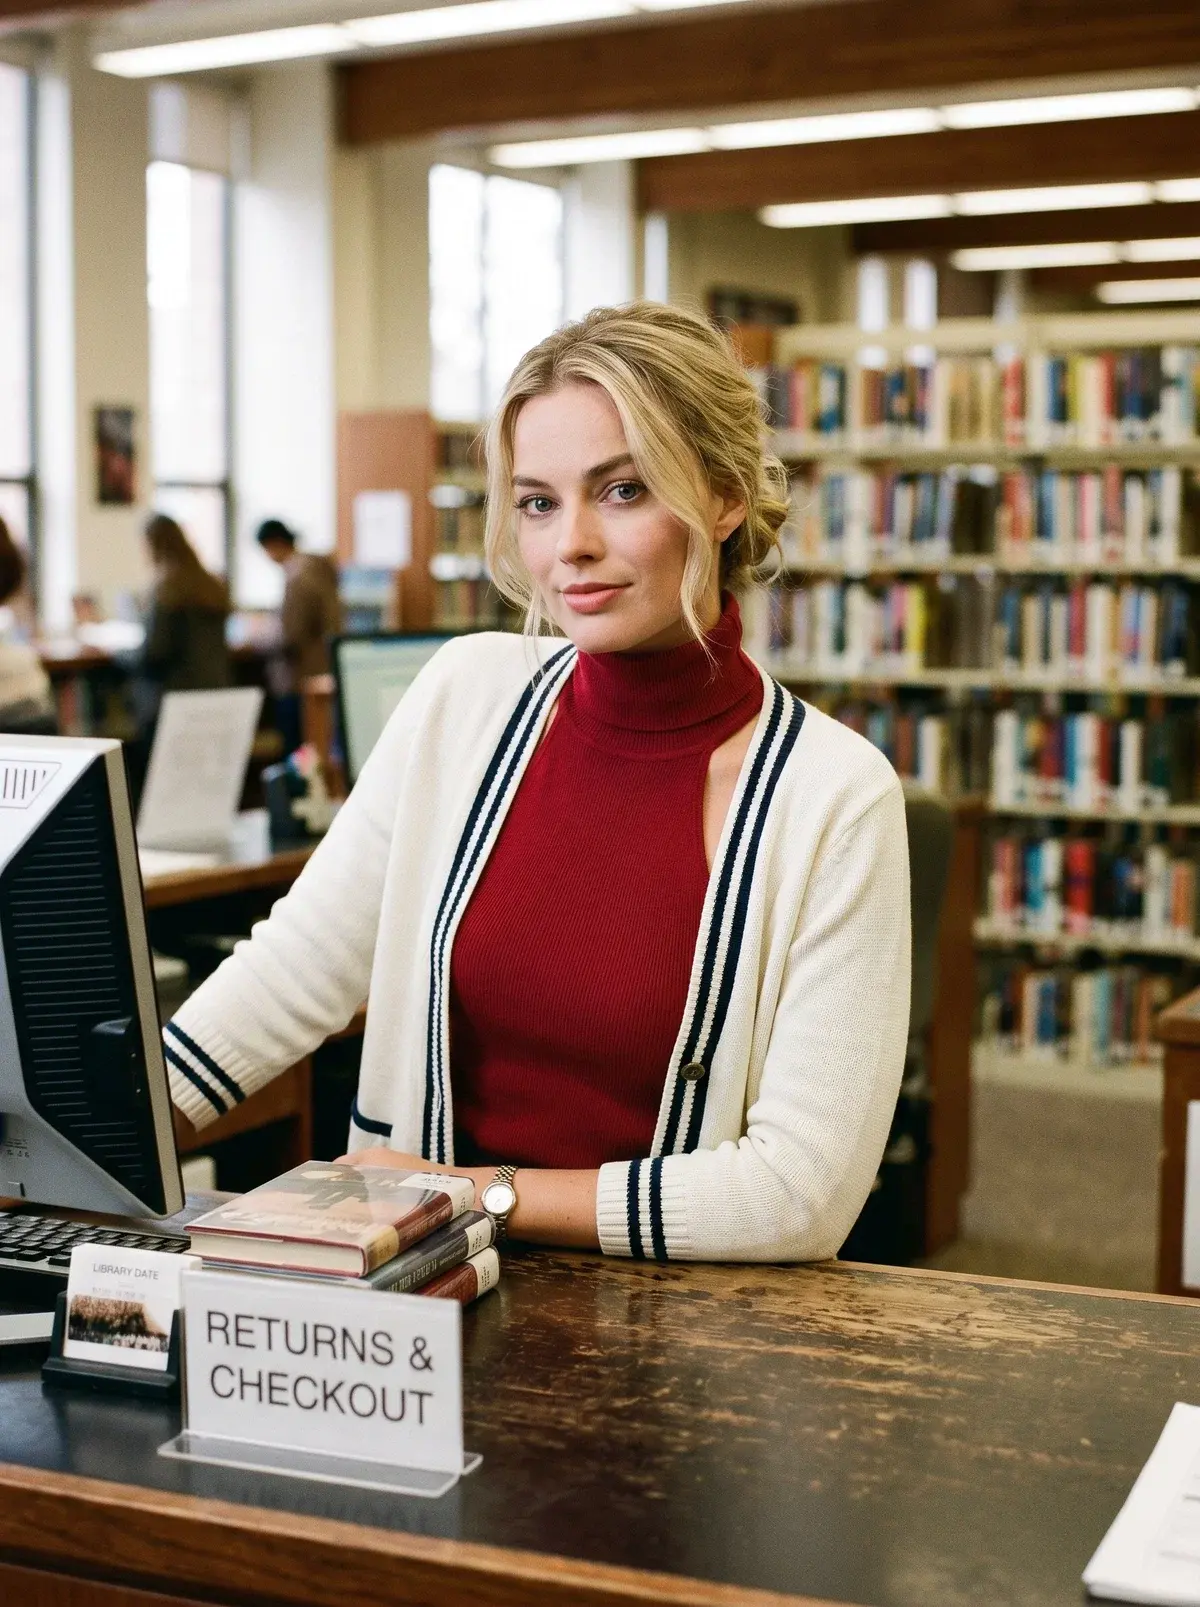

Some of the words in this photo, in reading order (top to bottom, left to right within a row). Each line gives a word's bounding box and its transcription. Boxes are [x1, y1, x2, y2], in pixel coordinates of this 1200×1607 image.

[93, 1263, 132, 1276] LIBRARY
[134, 1268, 159, 1280] DATE
[206, 1310, 394, 1367] RETURNS
[409, 1336, 434, 1372] &
[210, 1364, 434, 1425] CHECKOUT
